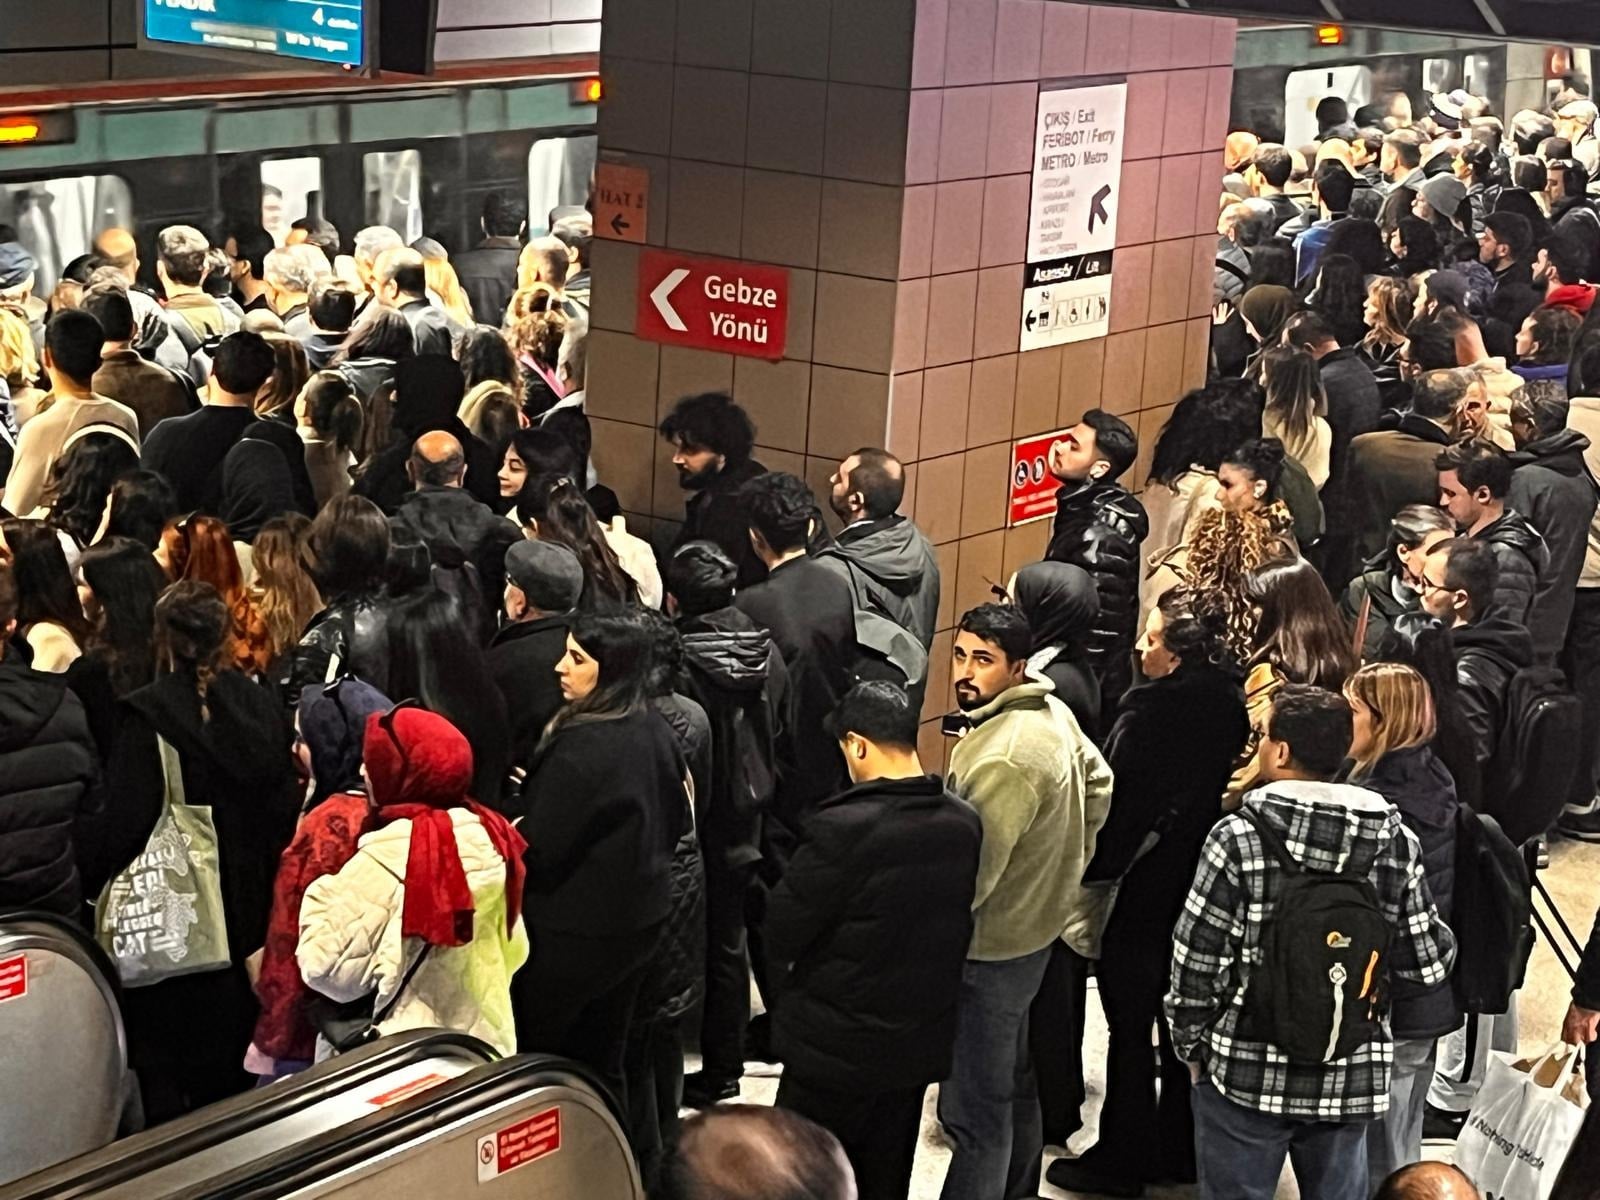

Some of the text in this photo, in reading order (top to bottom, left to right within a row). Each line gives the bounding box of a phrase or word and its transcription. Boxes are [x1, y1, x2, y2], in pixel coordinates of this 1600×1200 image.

[312, 7, 324, 26] 4
[1041, 152, 1076, 171] METRO
[704, 275, 777, 309] Gebze
[709, 311, 768, 344] Yönü
